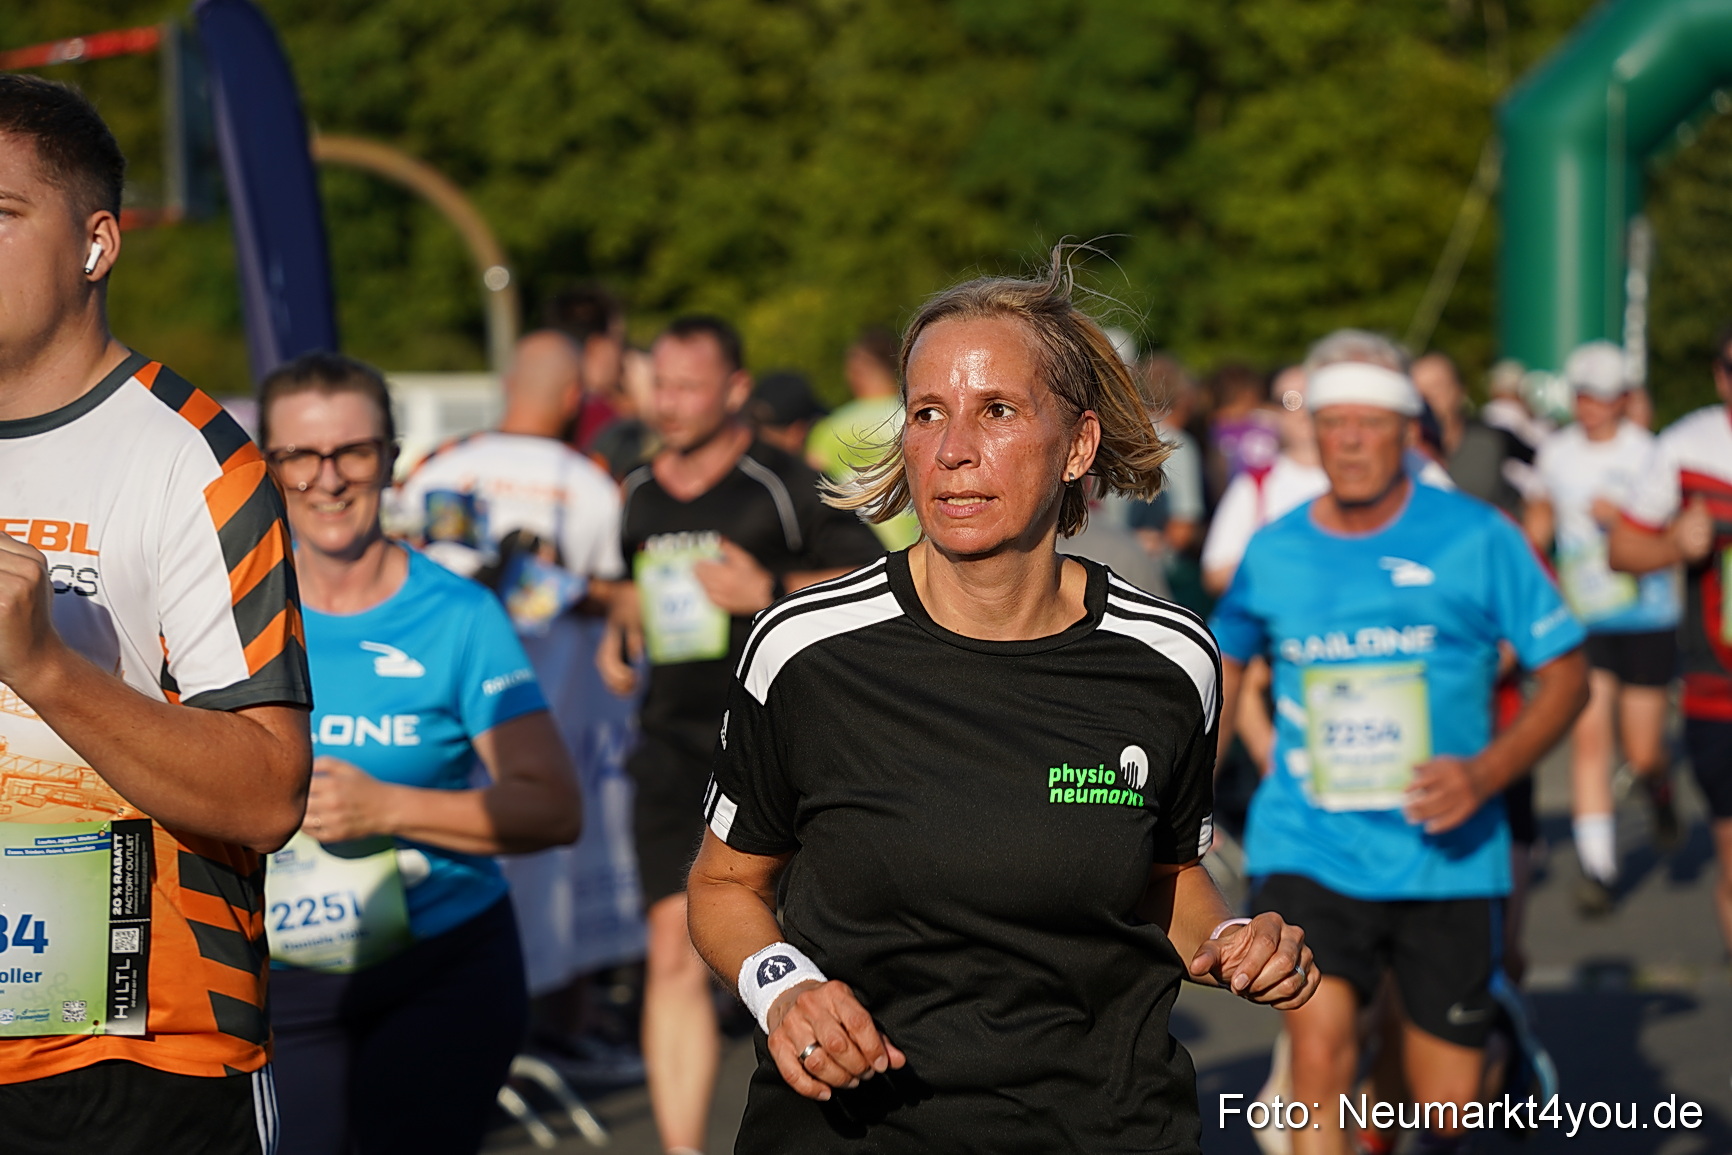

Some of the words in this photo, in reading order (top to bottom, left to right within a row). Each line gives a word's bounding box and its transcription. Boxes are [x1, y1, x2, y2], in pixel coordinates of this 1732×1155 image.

[311, 715, 420, 746] ONE
[1048, 763, 1116, 788] physio
[112, 834, 124, 885] RABATT
[124, 834, 134, 871] OUTLET
[112, 898, 123, 916] 20
[113, 886, 123, 897] %
[124, 872, 134, 915] FACTORY
[113, 958, 131, 1020] HILTL
